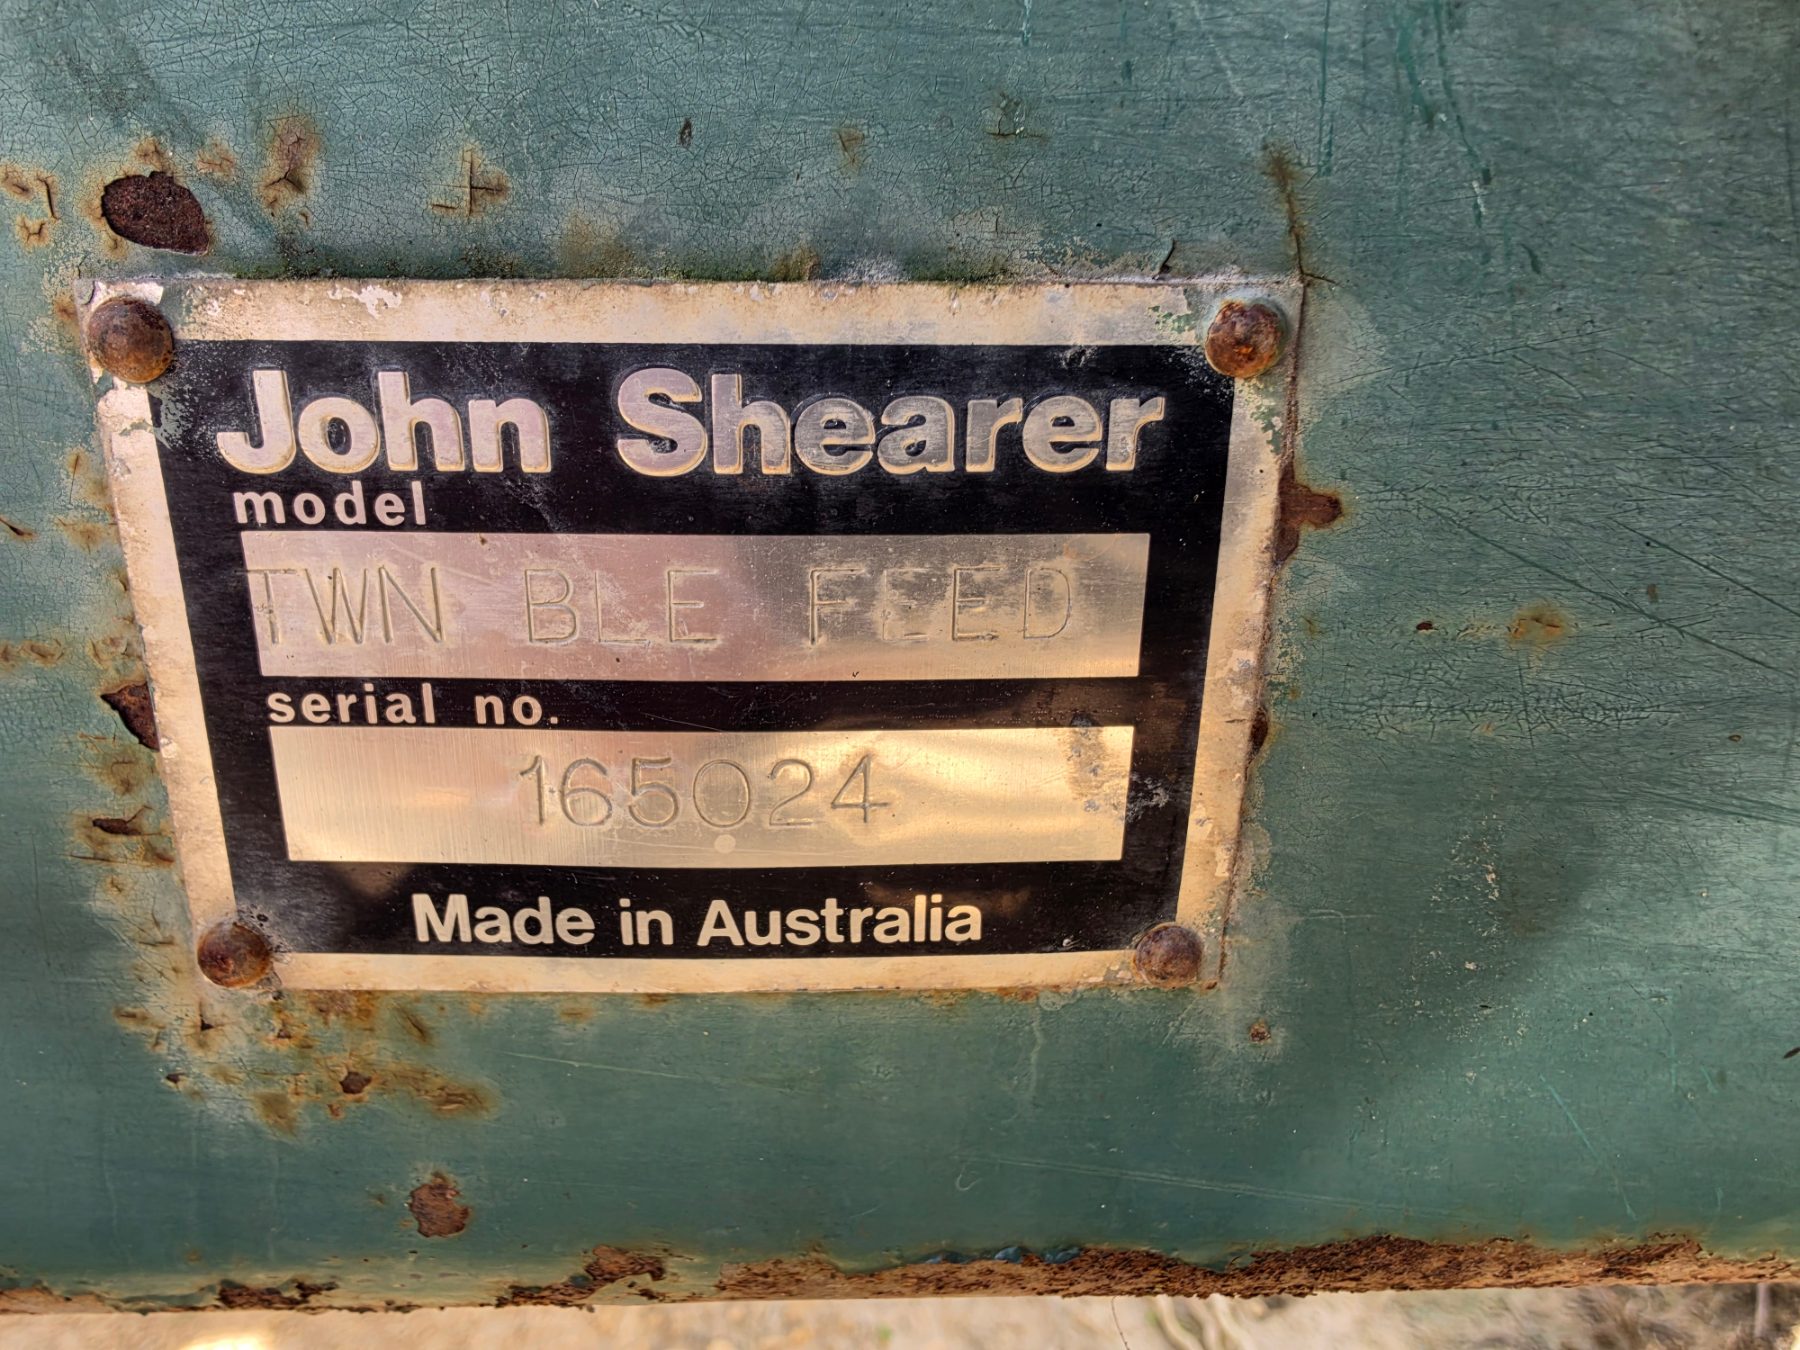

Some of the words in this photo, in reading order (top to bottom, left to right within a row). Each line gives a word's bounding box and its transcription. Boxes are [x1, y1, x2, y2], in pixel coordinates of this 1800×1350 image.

[217, 369, 552, 475] John
[616, 367, 1166, 477] Shearer
[233, 480, 427, 526] model
[235, 565, 445, 645] TWN
[808, 565, 1072, 645] FEED
[266, 682, 437, 725] serial
[474, 693, 559, 726] no.
[519, 753, 891, 828] 165024
[411, 893, 596, 946] Made
[618, 897, 674, 946] in
[696, 893, 983, 947] Australia
